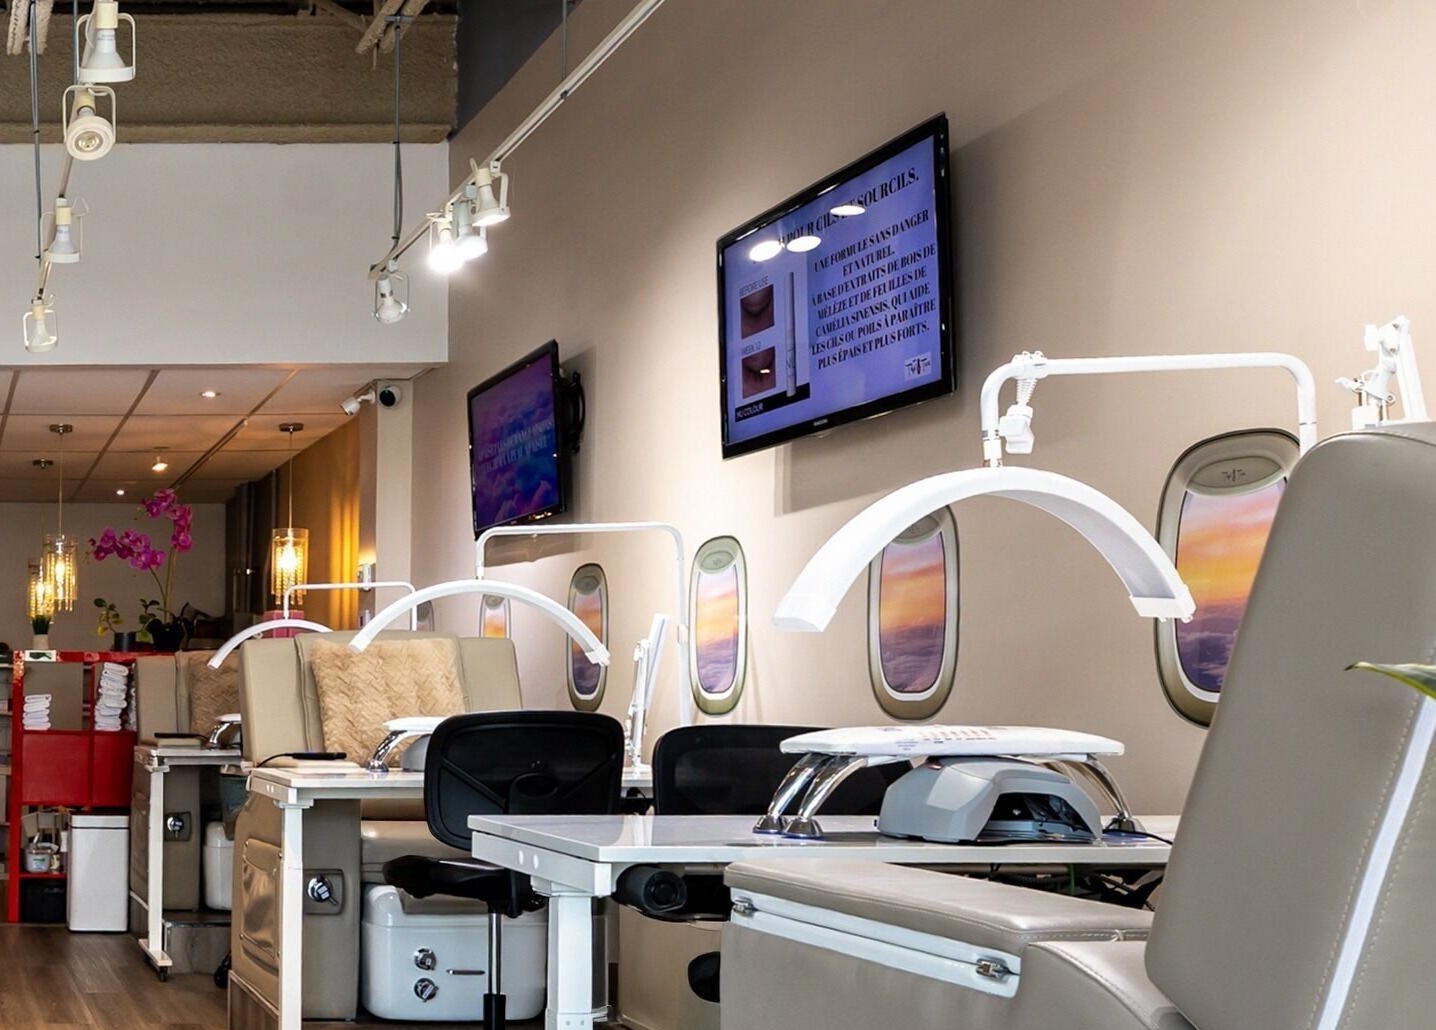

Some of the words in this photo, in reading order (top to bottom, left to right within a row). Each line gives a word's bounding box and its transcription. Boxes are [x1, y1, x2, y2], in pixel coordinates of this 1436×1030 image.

[857, 167, 919, 208] SOURCILS.
[814, 255, 830, 273] UNE
[830, 237, 868, 265] FORMULE
[868, 226, 891, 247] SANS
[891, 209, 929, 237] DANGER
[843, 262, 853, 277] ET
[854, 244, 895, 270] NATUREL.
[817, 286, 837, 304] BASE
[887, 258, 899, 274] DE
[900, 249, 922, 268] BOIS
[922, 243, 936, 259] DE
[848, 294, 859, 308] ET
[860, 286, 872, 303] DE
[872, 271, 913, 298] FEUILLES
[914, 264, 927, 280] DE
[891, 290, 907, 310] QUI
[909, 282, 930, 300] AIDE
[811, 339, 826, 356] LES
[826, 333, 844, 350] CILS
[844, 329, 857, 343] OU
[857, 320, 882, 338] POILS
[818, 353, 837, 370] PLUS
[862, 340, 874, 354] ET
[874, 331, 897, 350] PLUS
[896, 320, 930, 342] FORTS.
